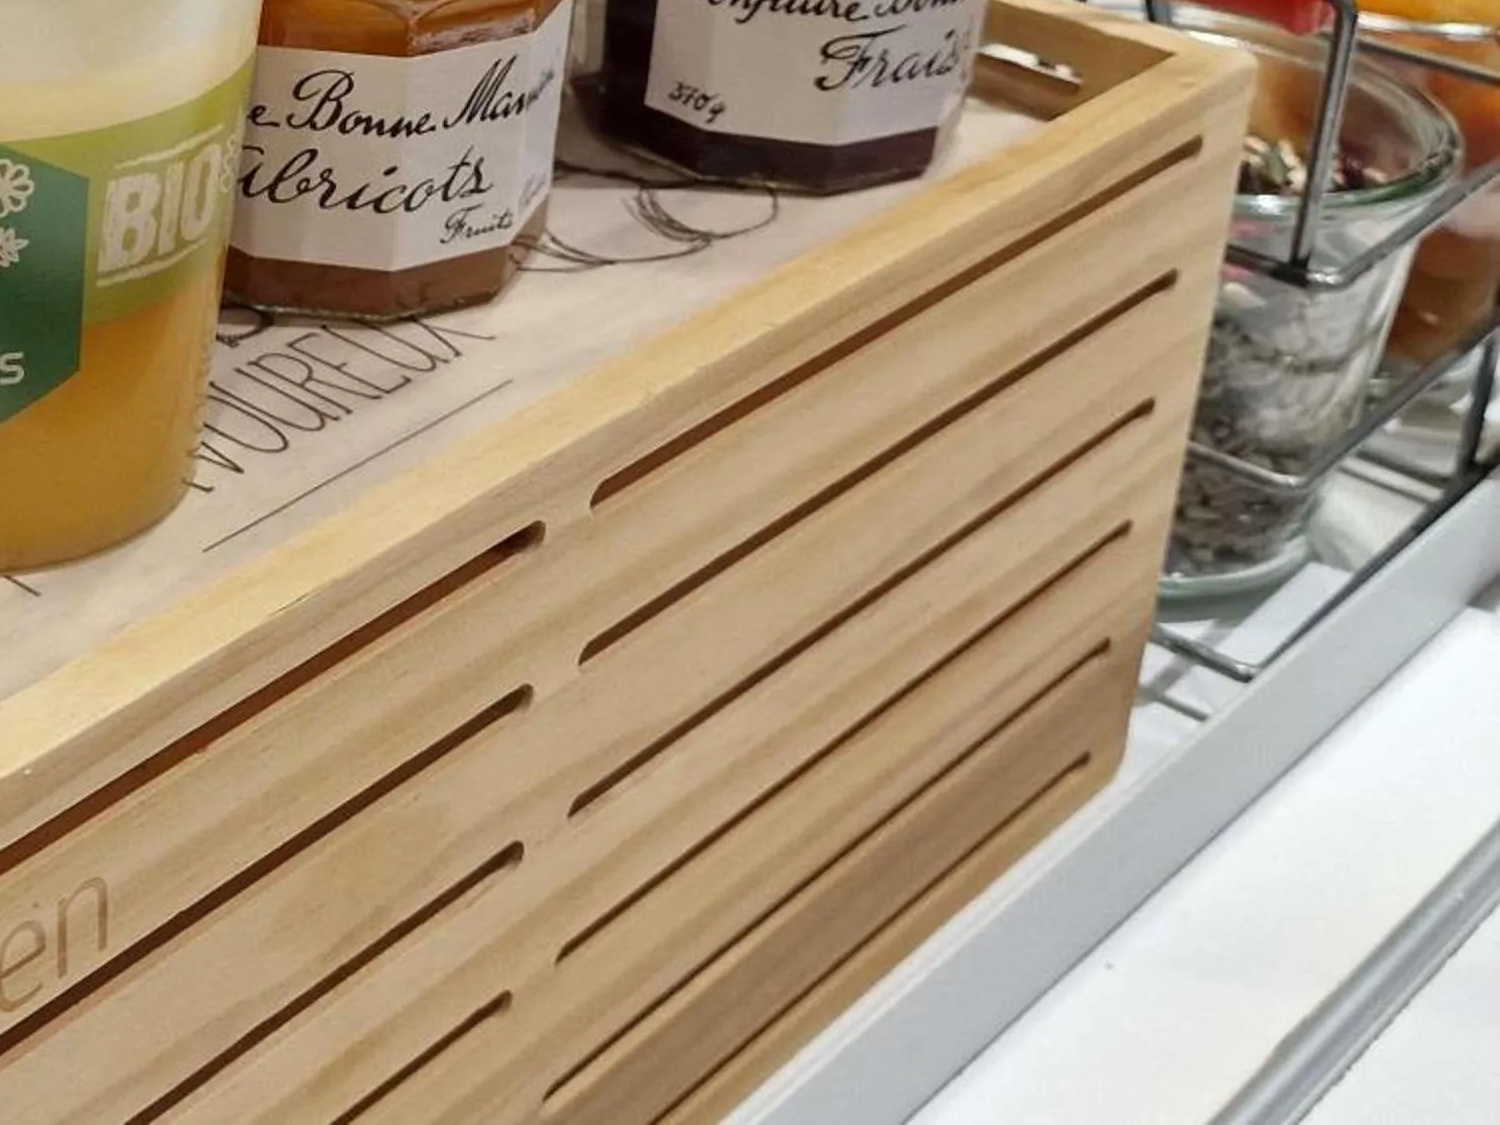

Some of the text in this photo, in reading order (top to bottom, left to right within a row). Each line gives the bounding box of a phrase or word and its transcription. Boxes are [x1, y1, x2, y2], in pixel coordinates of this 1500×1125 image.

[813, 25, 962, 92] Frais
[286, 68, 438, 139] Bonne
[98, 144, 224, 274] BIO
[439, 203, 513, 244] Fruits
